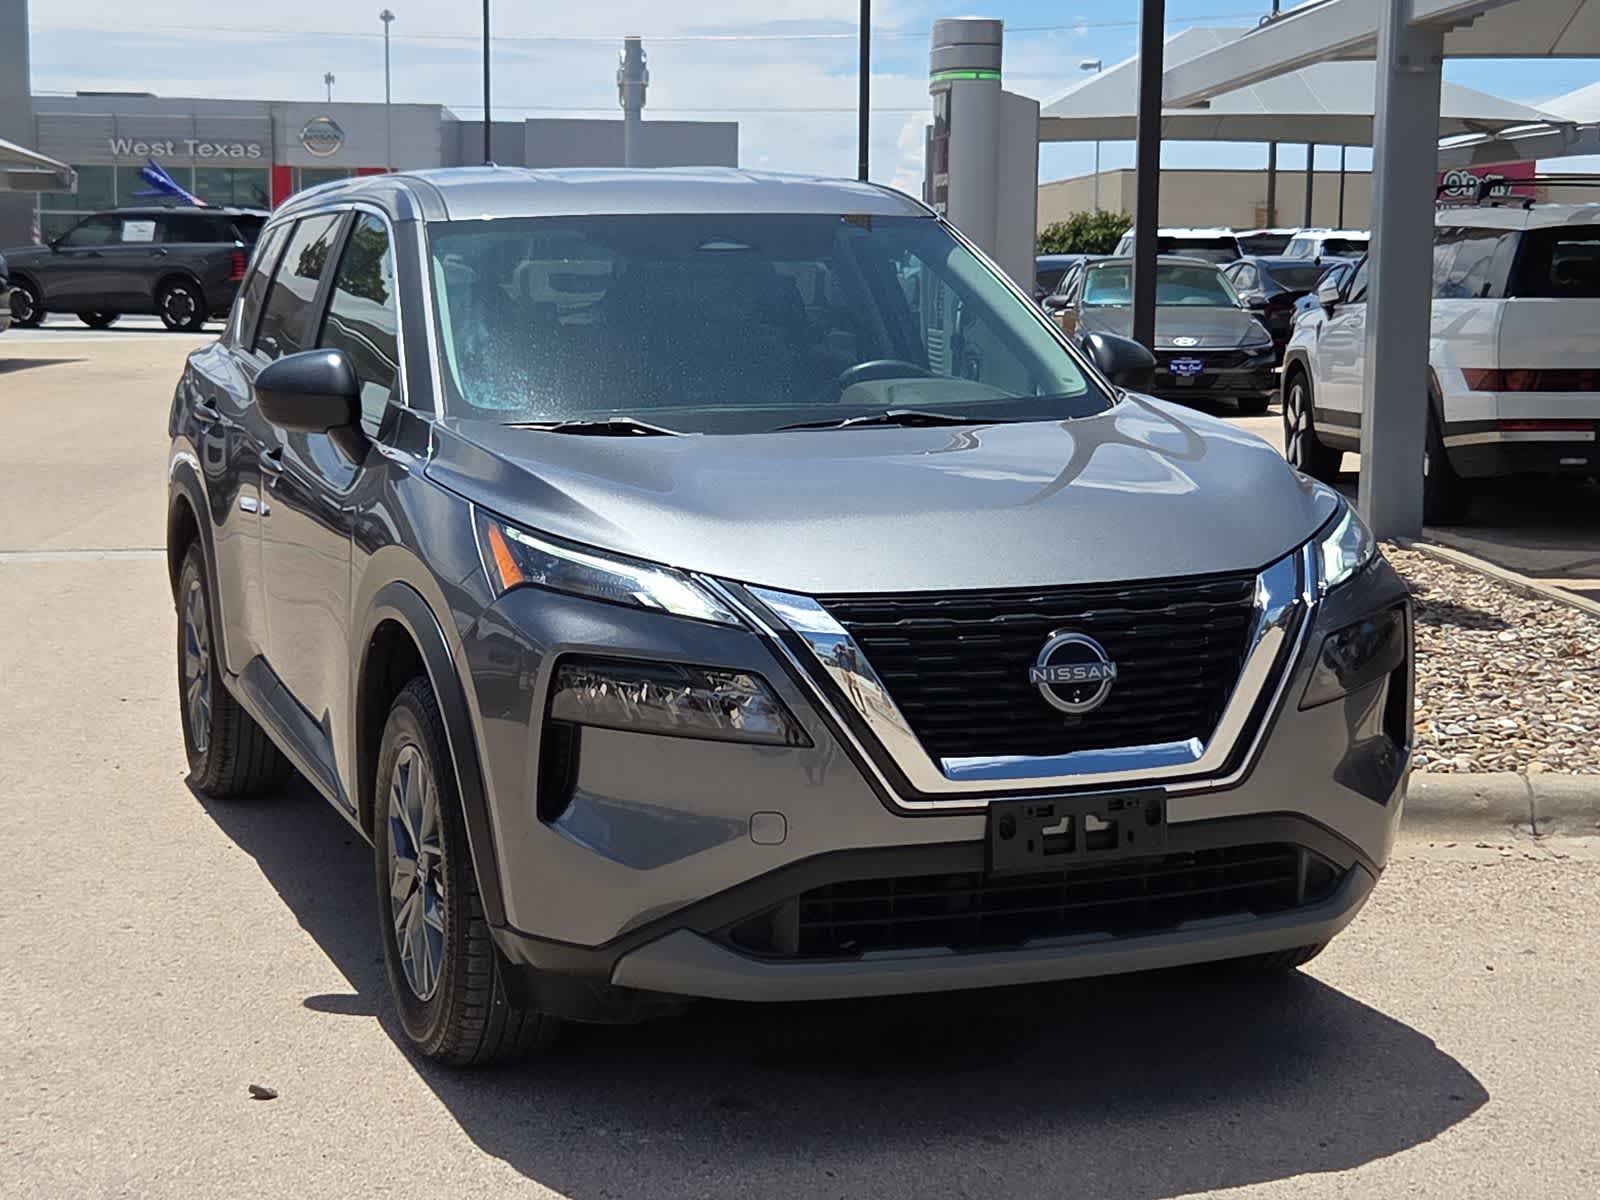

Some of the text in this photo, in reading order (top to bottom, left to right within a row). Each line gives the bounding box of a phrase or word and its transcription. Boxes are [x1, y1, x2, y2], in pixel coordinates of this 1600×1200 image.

[109, 137, 262, 159] West Texas
[1032, 662, 1116, 681] NISSAN
